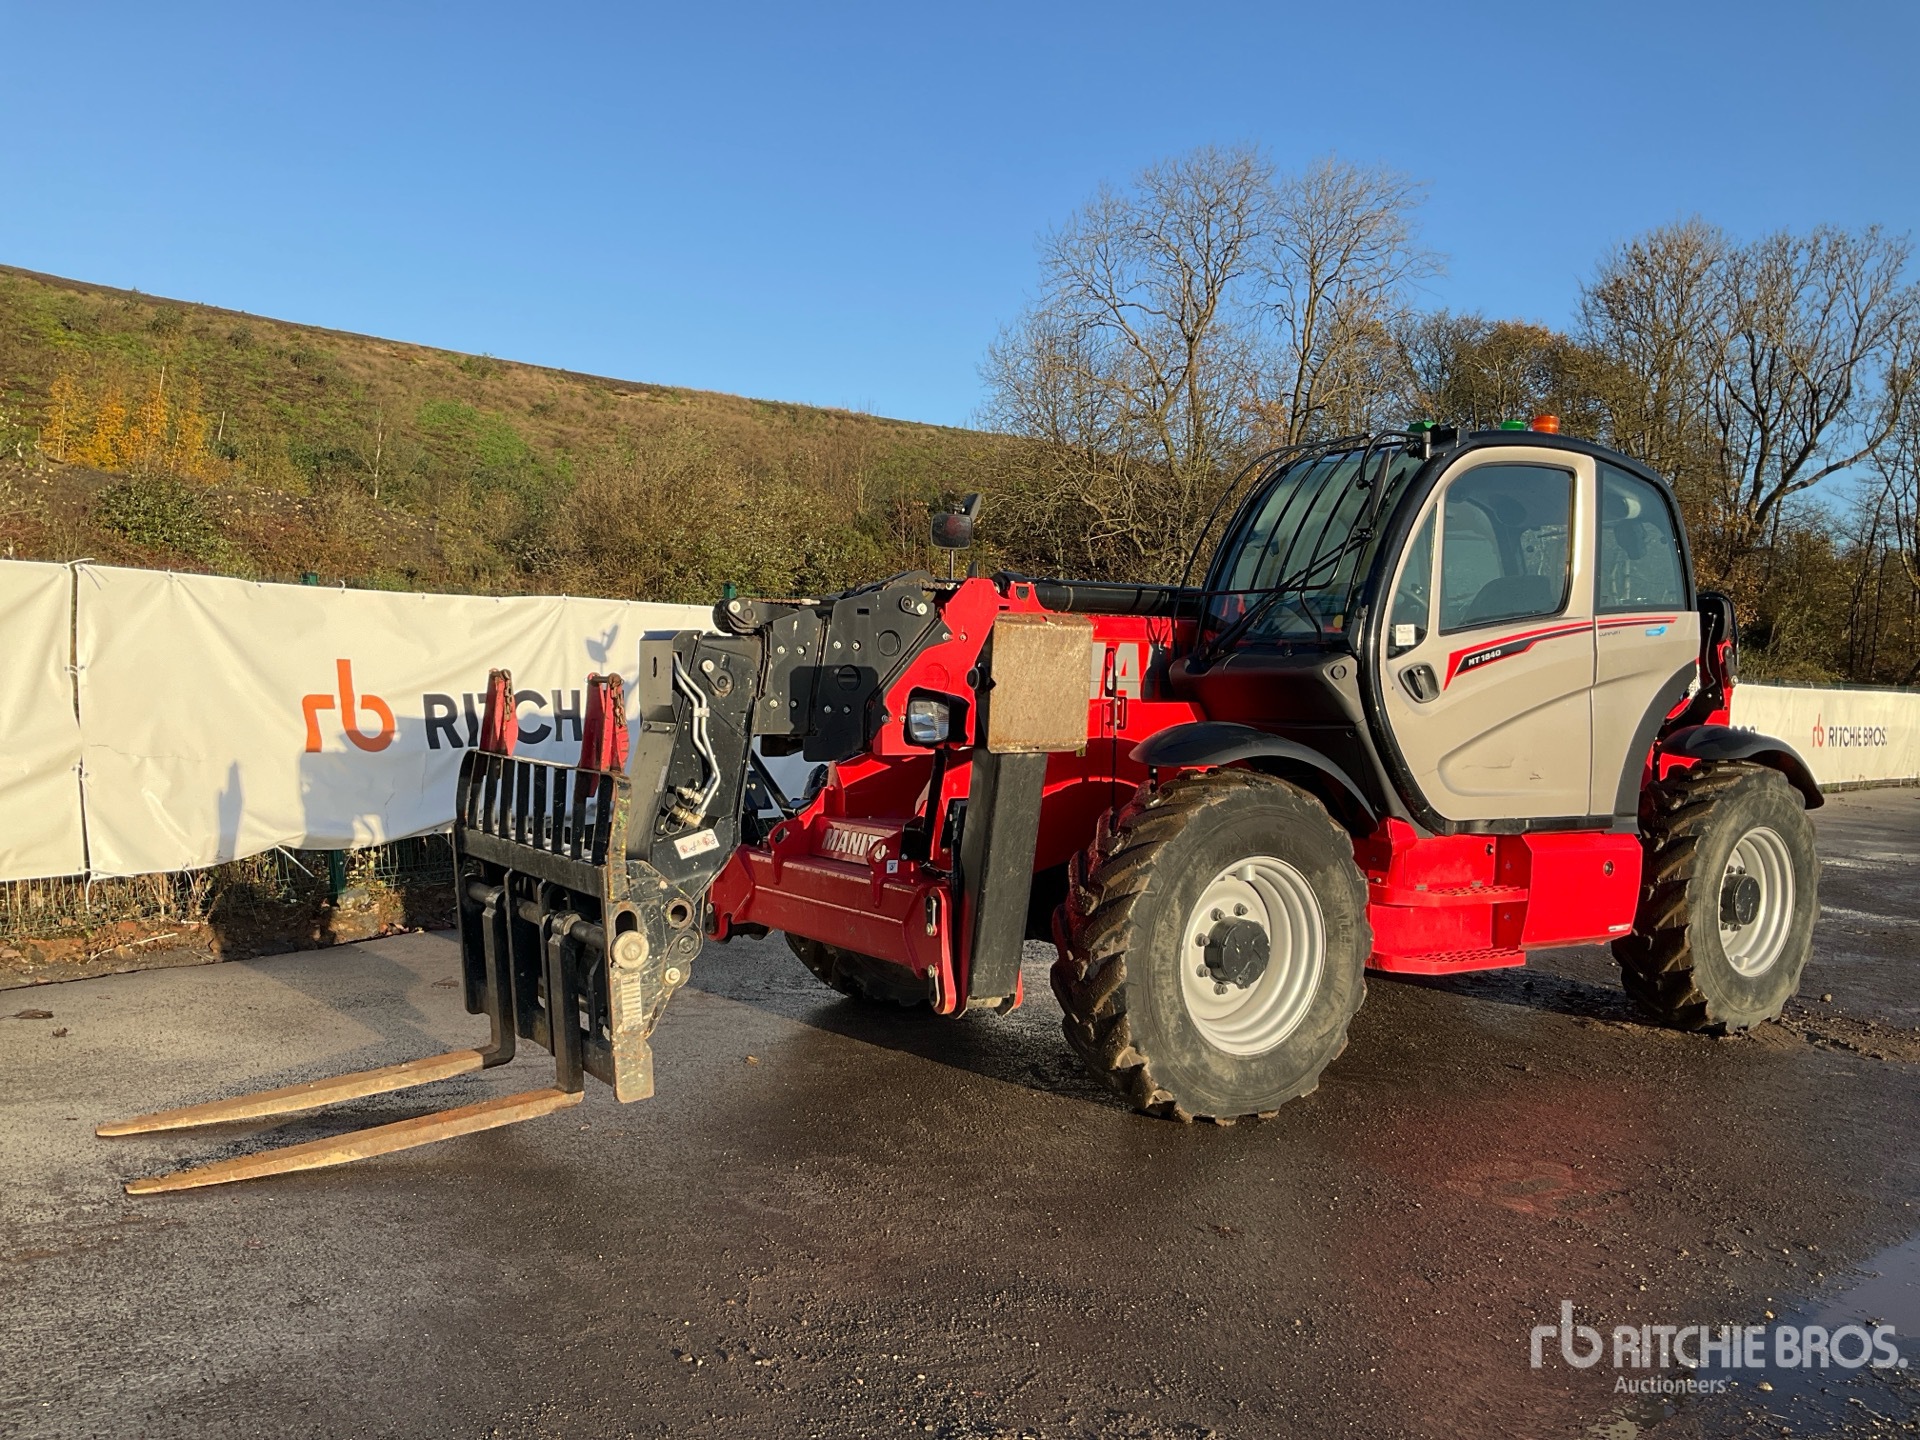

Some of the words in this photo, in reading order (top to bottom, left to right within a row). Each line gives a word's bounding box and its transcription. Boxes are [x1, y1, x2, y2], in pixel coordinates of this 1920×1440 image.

[1468, 656, 1480, 666] MT
[1481, 650, 1501, 661] 1840
[422, 689, 625, 750] RICH
[1828, 726, 1862, 747] RITCHIE
